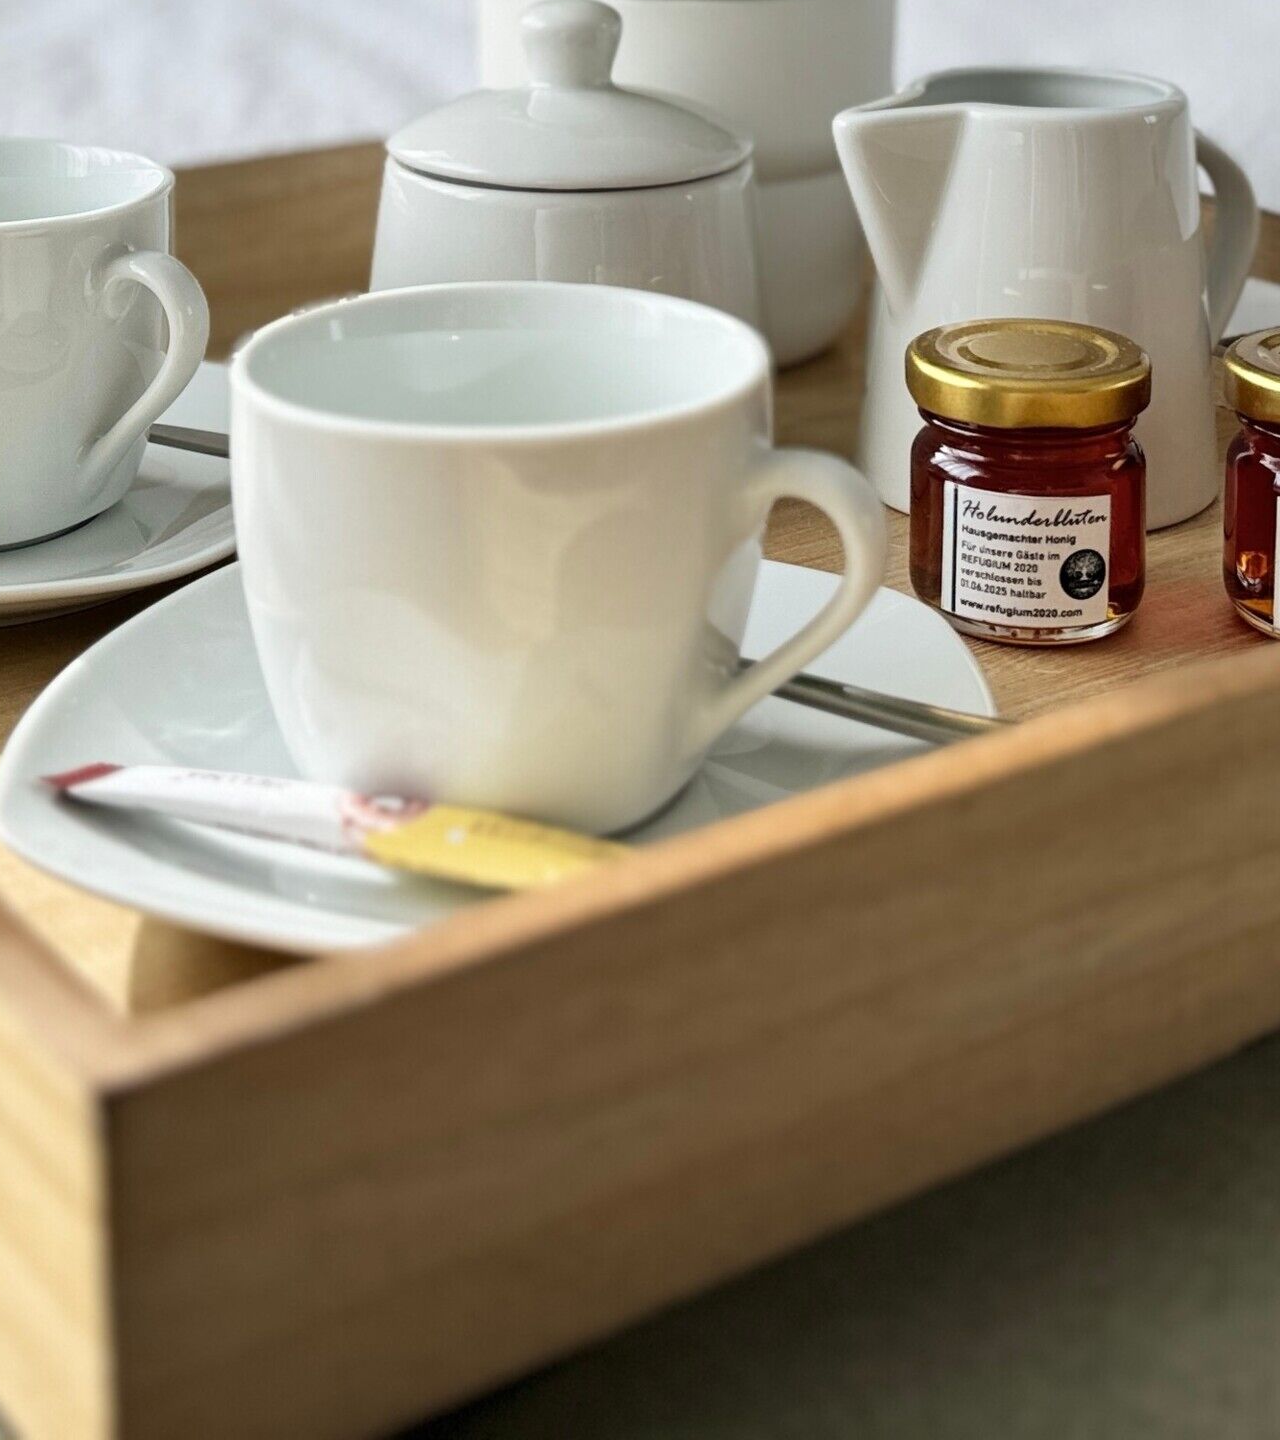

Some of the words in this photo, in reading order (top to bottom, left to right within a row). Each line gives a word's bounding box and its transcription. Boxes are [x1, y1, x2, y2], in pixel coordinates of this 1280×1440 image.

[961, 524, 1043, 544] Hausgemachter
[1045, 534, 1077, 546] Honig
[961, 539, 978, 552] Für
[979, 544, 1013, 558] unsere
[1015, 549, 1045, 561] Gäste
[1047, 551, 1061, 561] im
[961, 553, 1011, 571] REFUGIUM
[1013, 562, 1039, 573] 2020
[961, 568, 1024, 585] verschlossen
[1027, 575, 1042, 586] bis
[960, 578, 1007, 596] 01.06.2025
[1010, 587, 1047, 599] haltbar
[960, 598, 1083, 618] www.refugium2020.com
